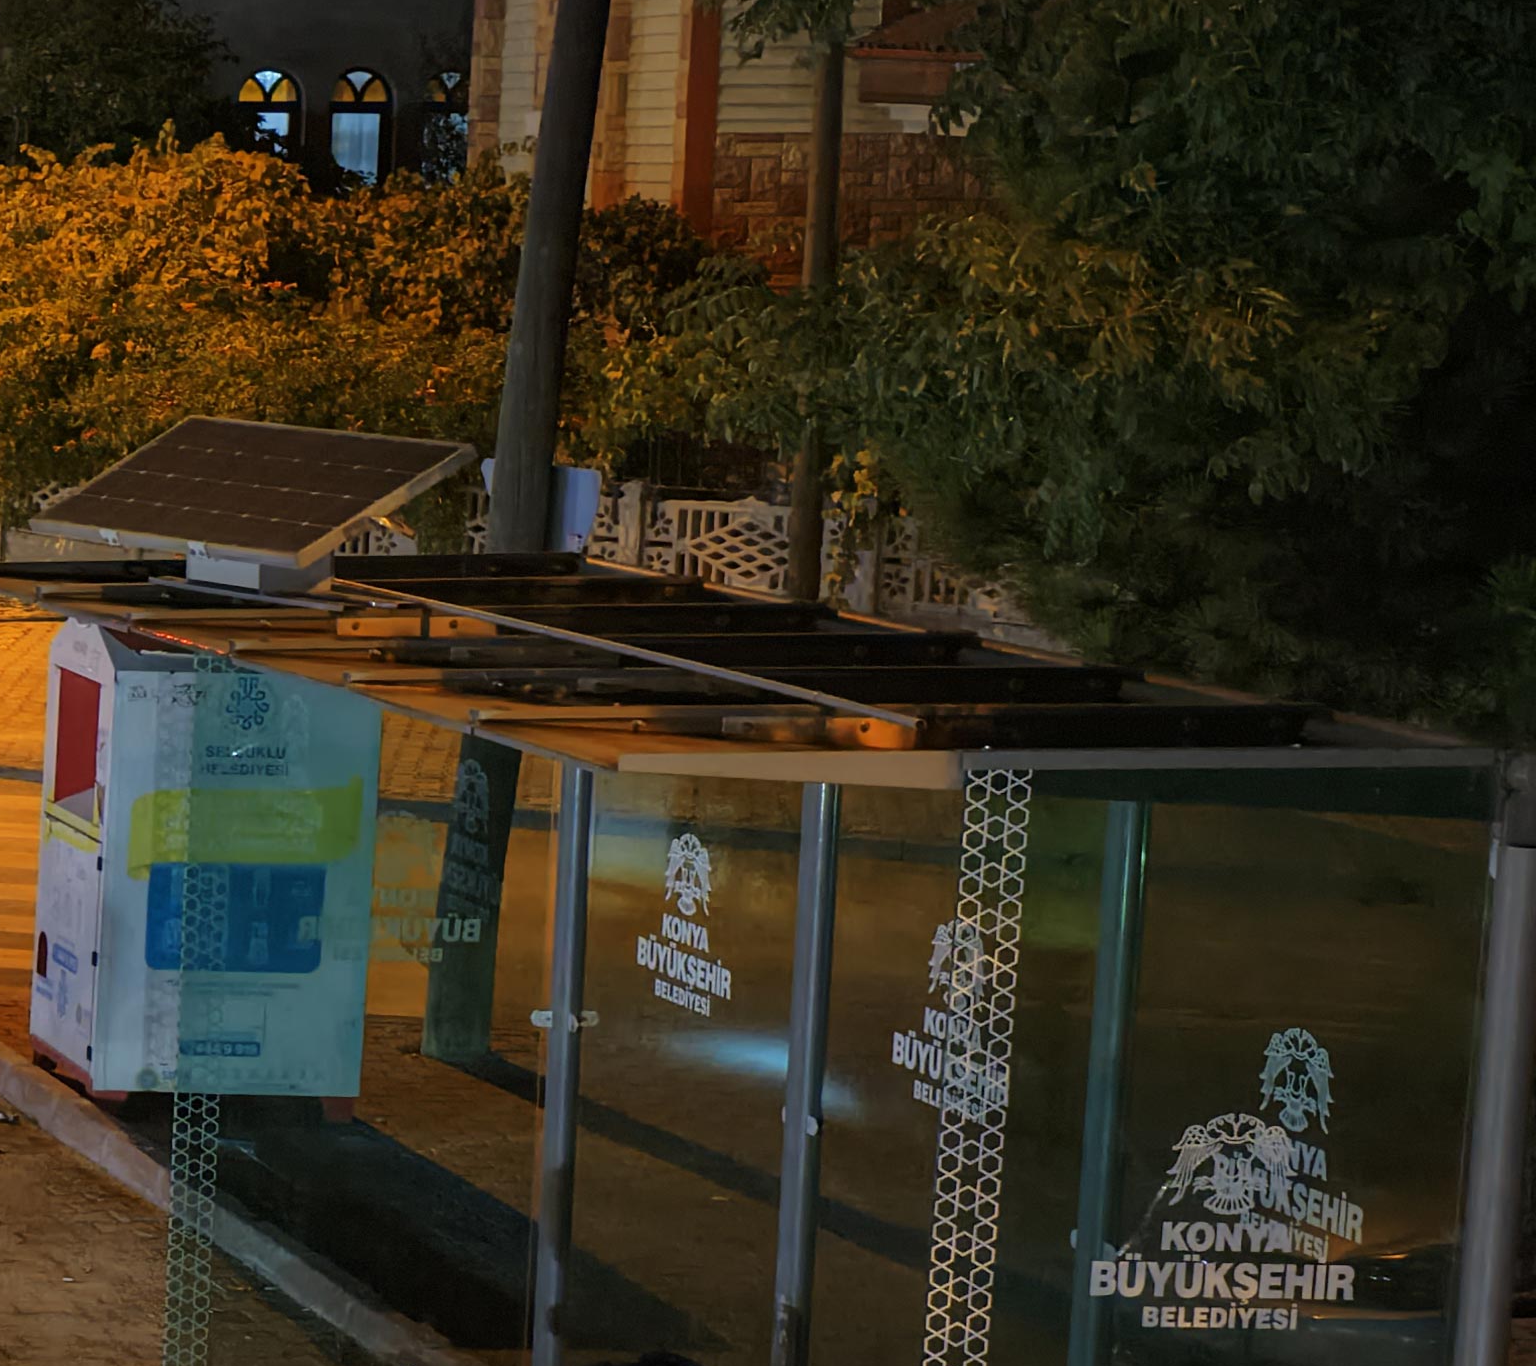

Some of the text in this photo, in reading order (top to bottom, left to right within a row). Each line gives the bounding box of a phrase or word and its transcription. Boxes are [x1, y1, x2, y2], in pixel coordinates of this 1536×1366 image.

[661, 912, 710, 954] KONYA
[636, 933, 732, 1000] BÜYÜKŞEHİR
[654, 978, 711, 1017] BELEDİYESİ
[1160, 1221, 1294, 1253] KONYA
[1089, 1252, 1356, 1306] BÜYÜKŞEHİR
[1141, 1301, 1299, 1331] BELEDİYESİ
